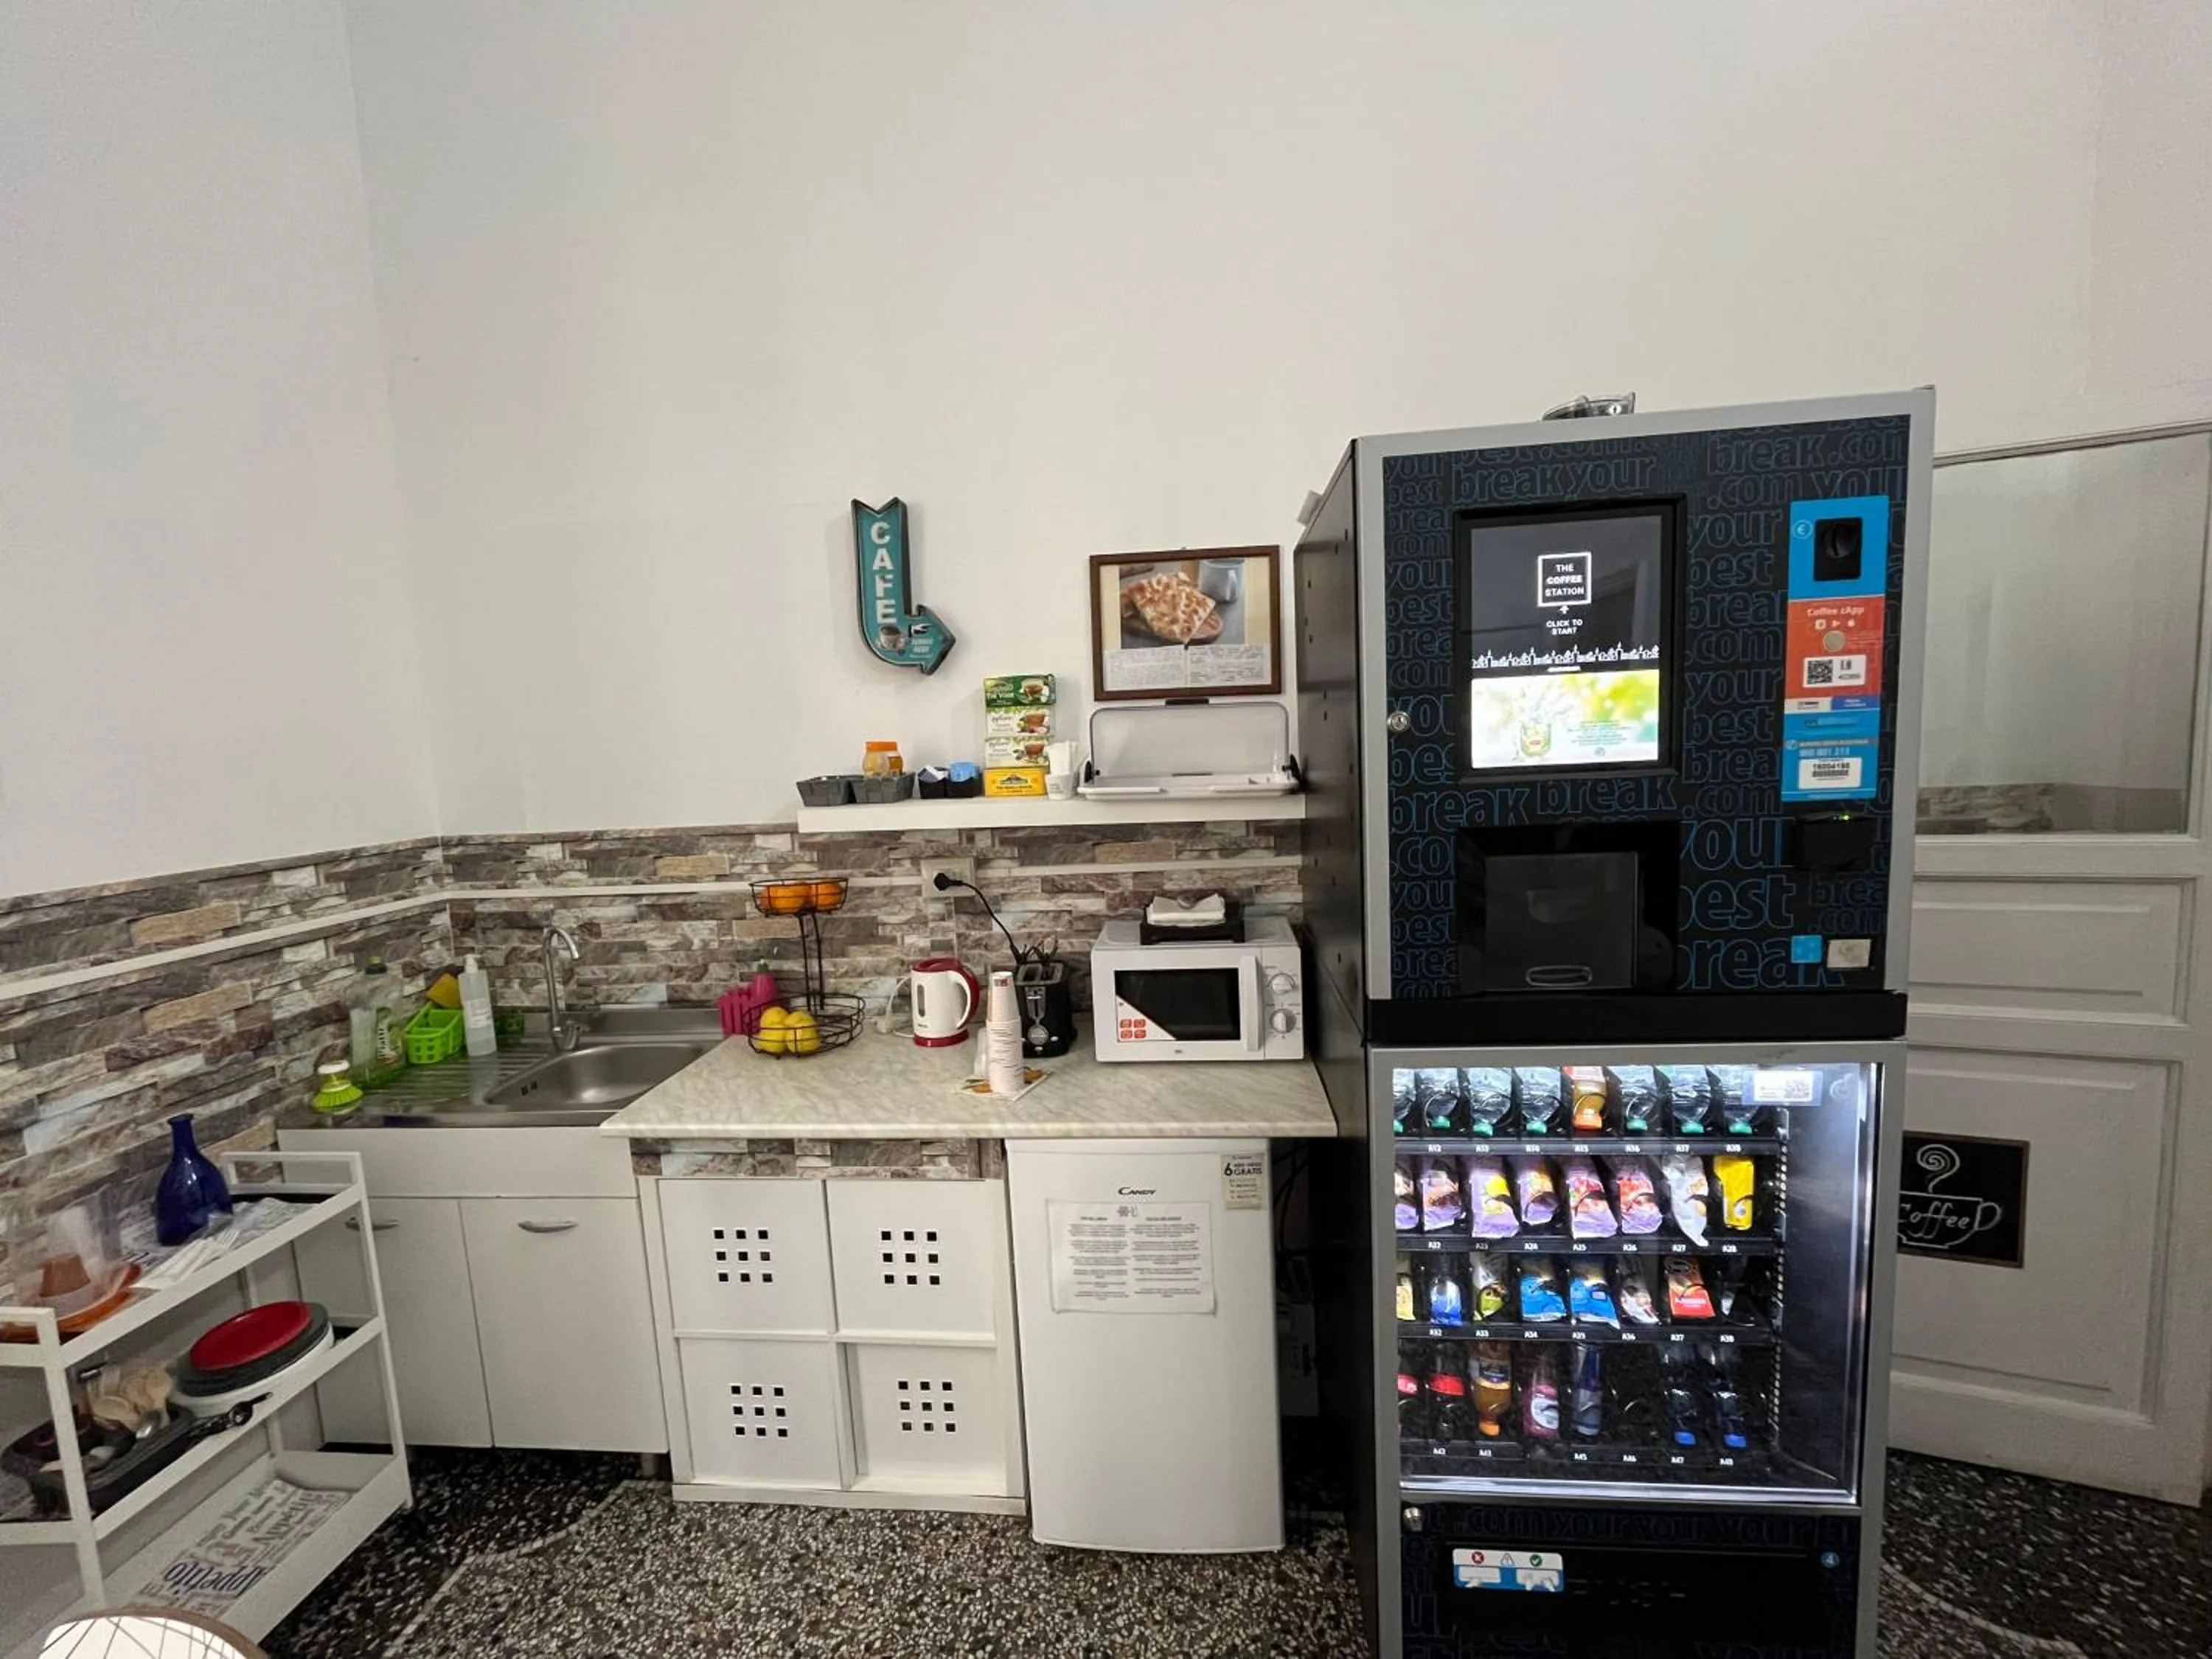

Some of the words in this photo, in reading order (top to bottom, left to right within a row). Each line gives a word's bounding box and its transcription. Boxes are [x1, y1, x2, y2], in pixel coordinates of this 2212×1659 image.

[871, 521, 897, 624] CAFE
[1555, 563, 1575, 572] THE
[1545, 574, 1583, 585] COFFEE
[1545, 586, 1585, 597] STATION
[1687, 585, 1786, 628] brea
[1546, 619, 1570, 627] CLICK
[1572, 619, 1583, 627] TO
[1551, 627, 1578, 636] START
[1387, 627, 1453, 658] brea
[1683, 743, 1781, 783] brea
[1225, 1162, 1233, 1176] 6
[1234, 1167, 1262, 1176] GRATIS
